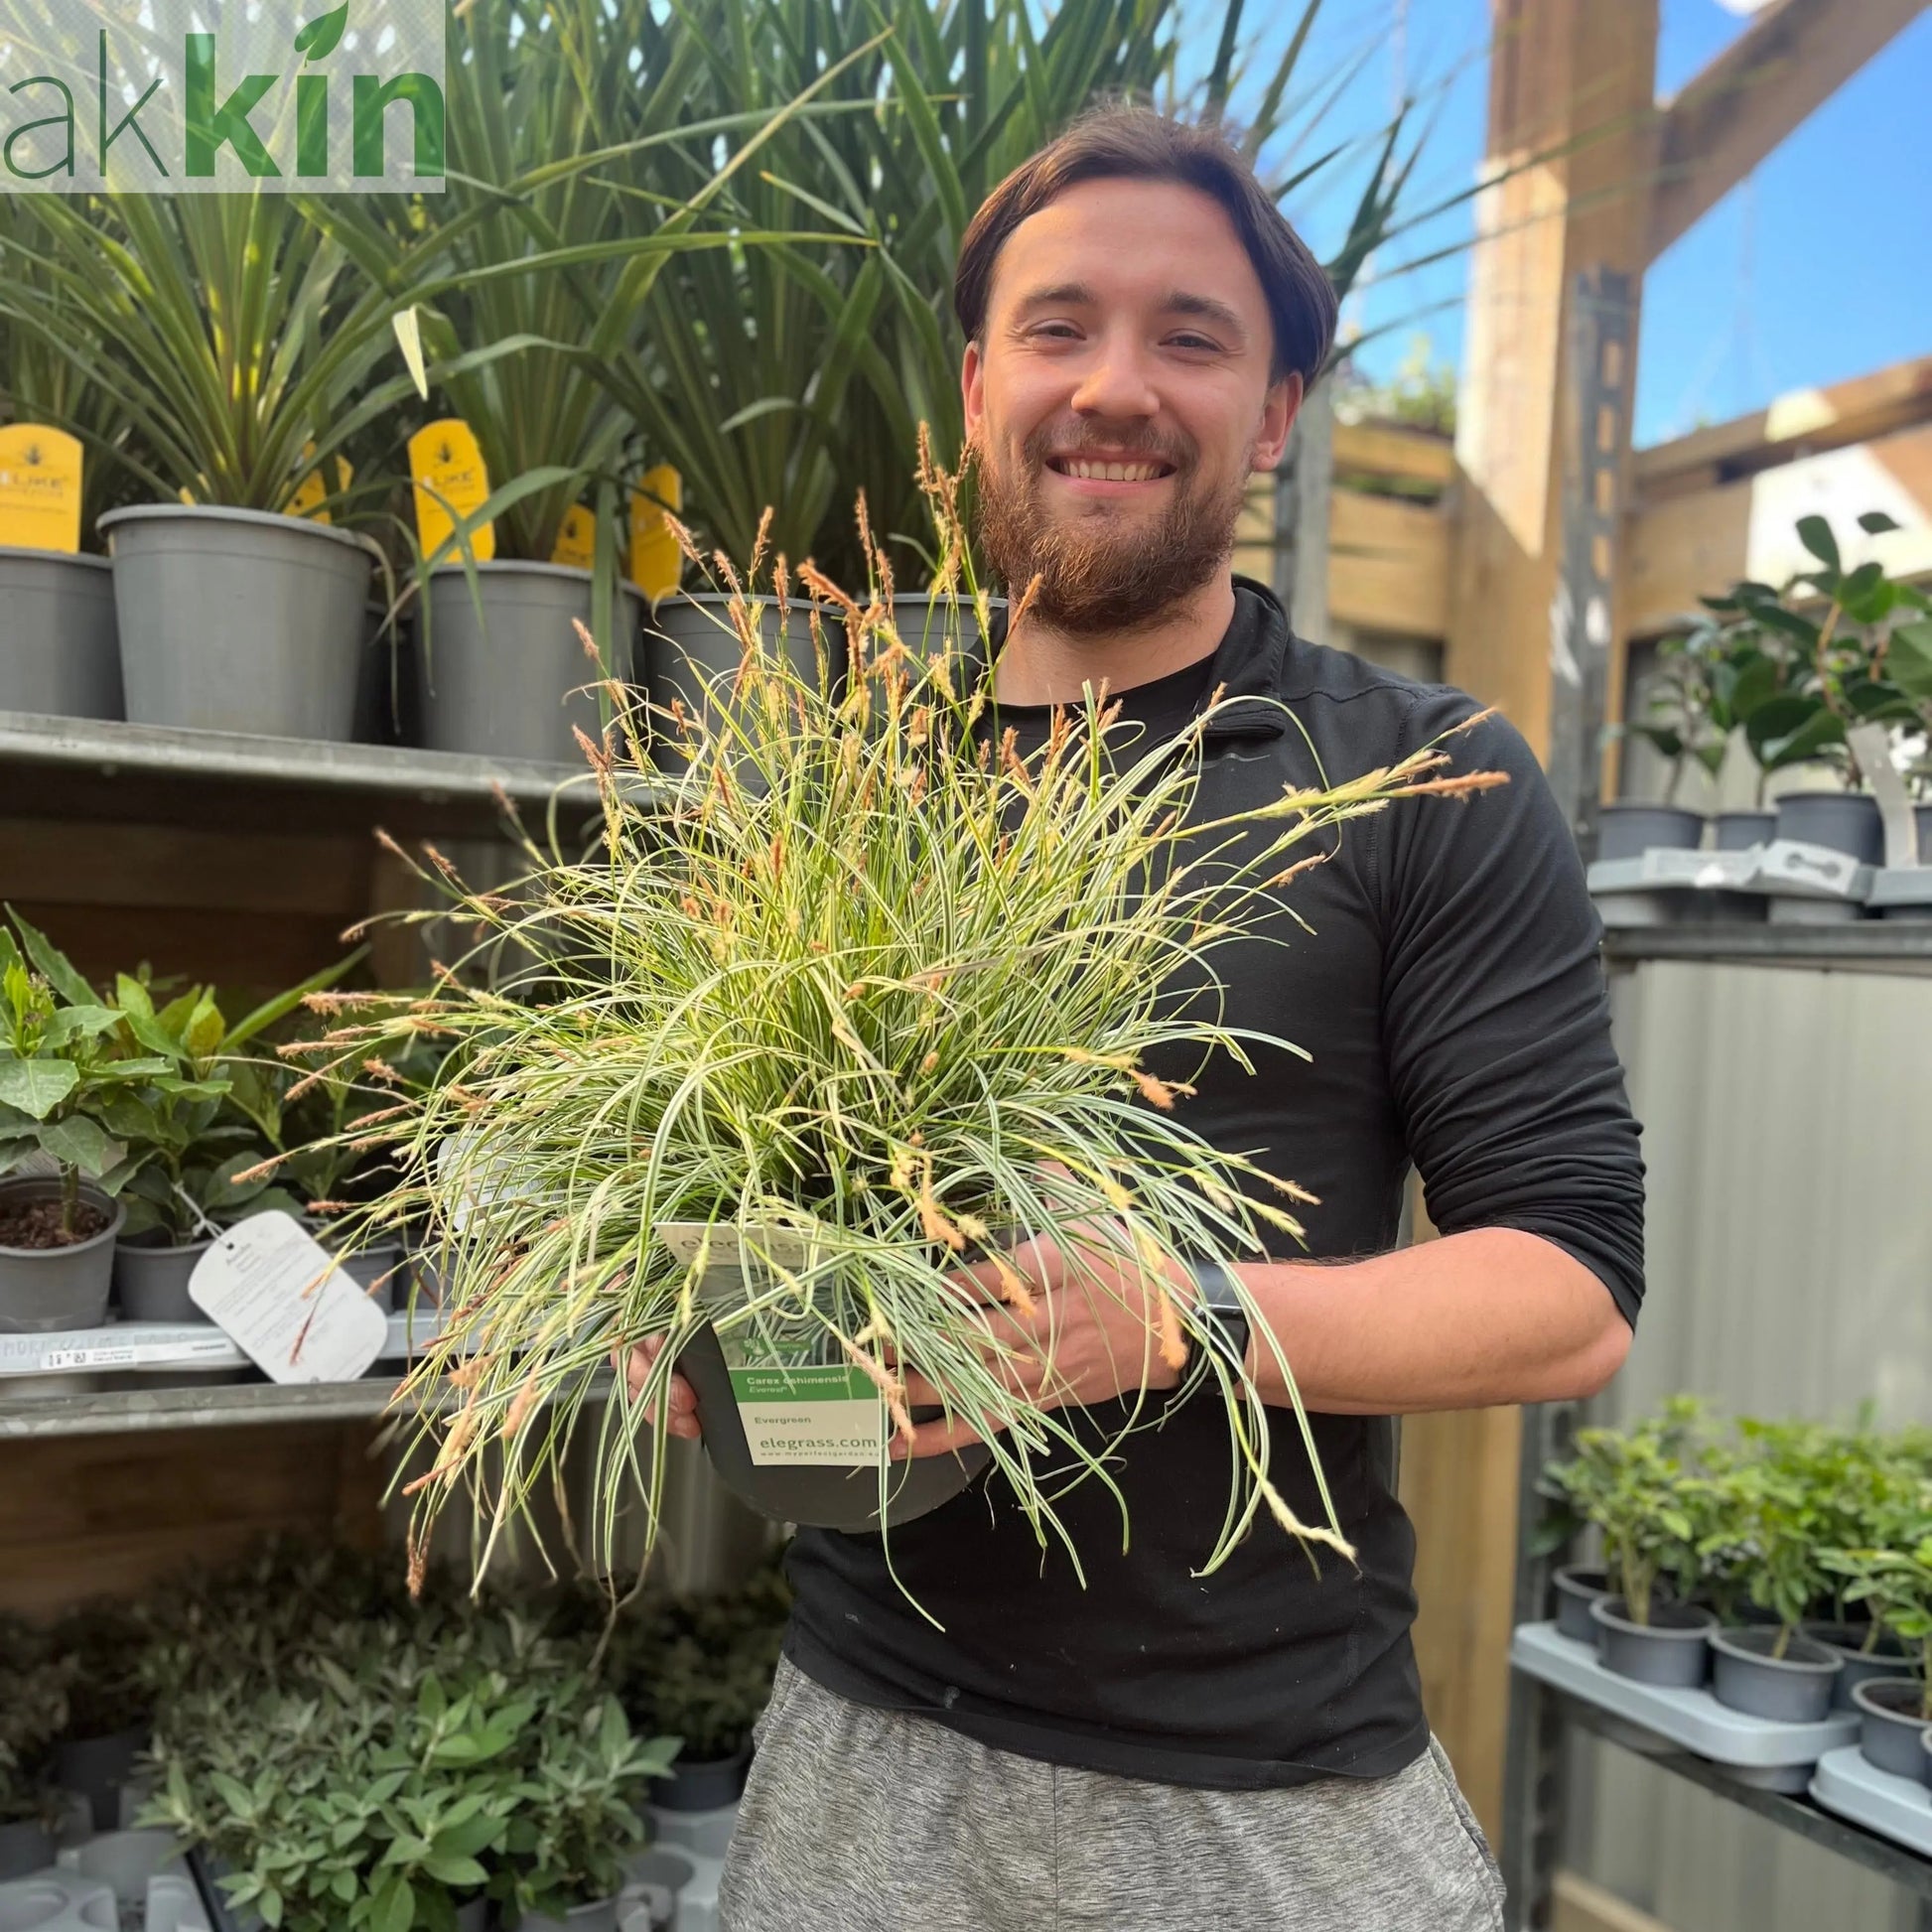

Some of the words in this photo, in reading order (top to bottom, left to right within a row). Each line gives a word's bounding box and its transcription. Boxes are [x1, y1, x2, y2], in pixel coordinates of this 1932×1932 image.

[746, 1376, 780, 1386] Carex
[754, 1416, 812, 1426] Evergreen
[759, 1437, 878, 1450] elegrass.com
